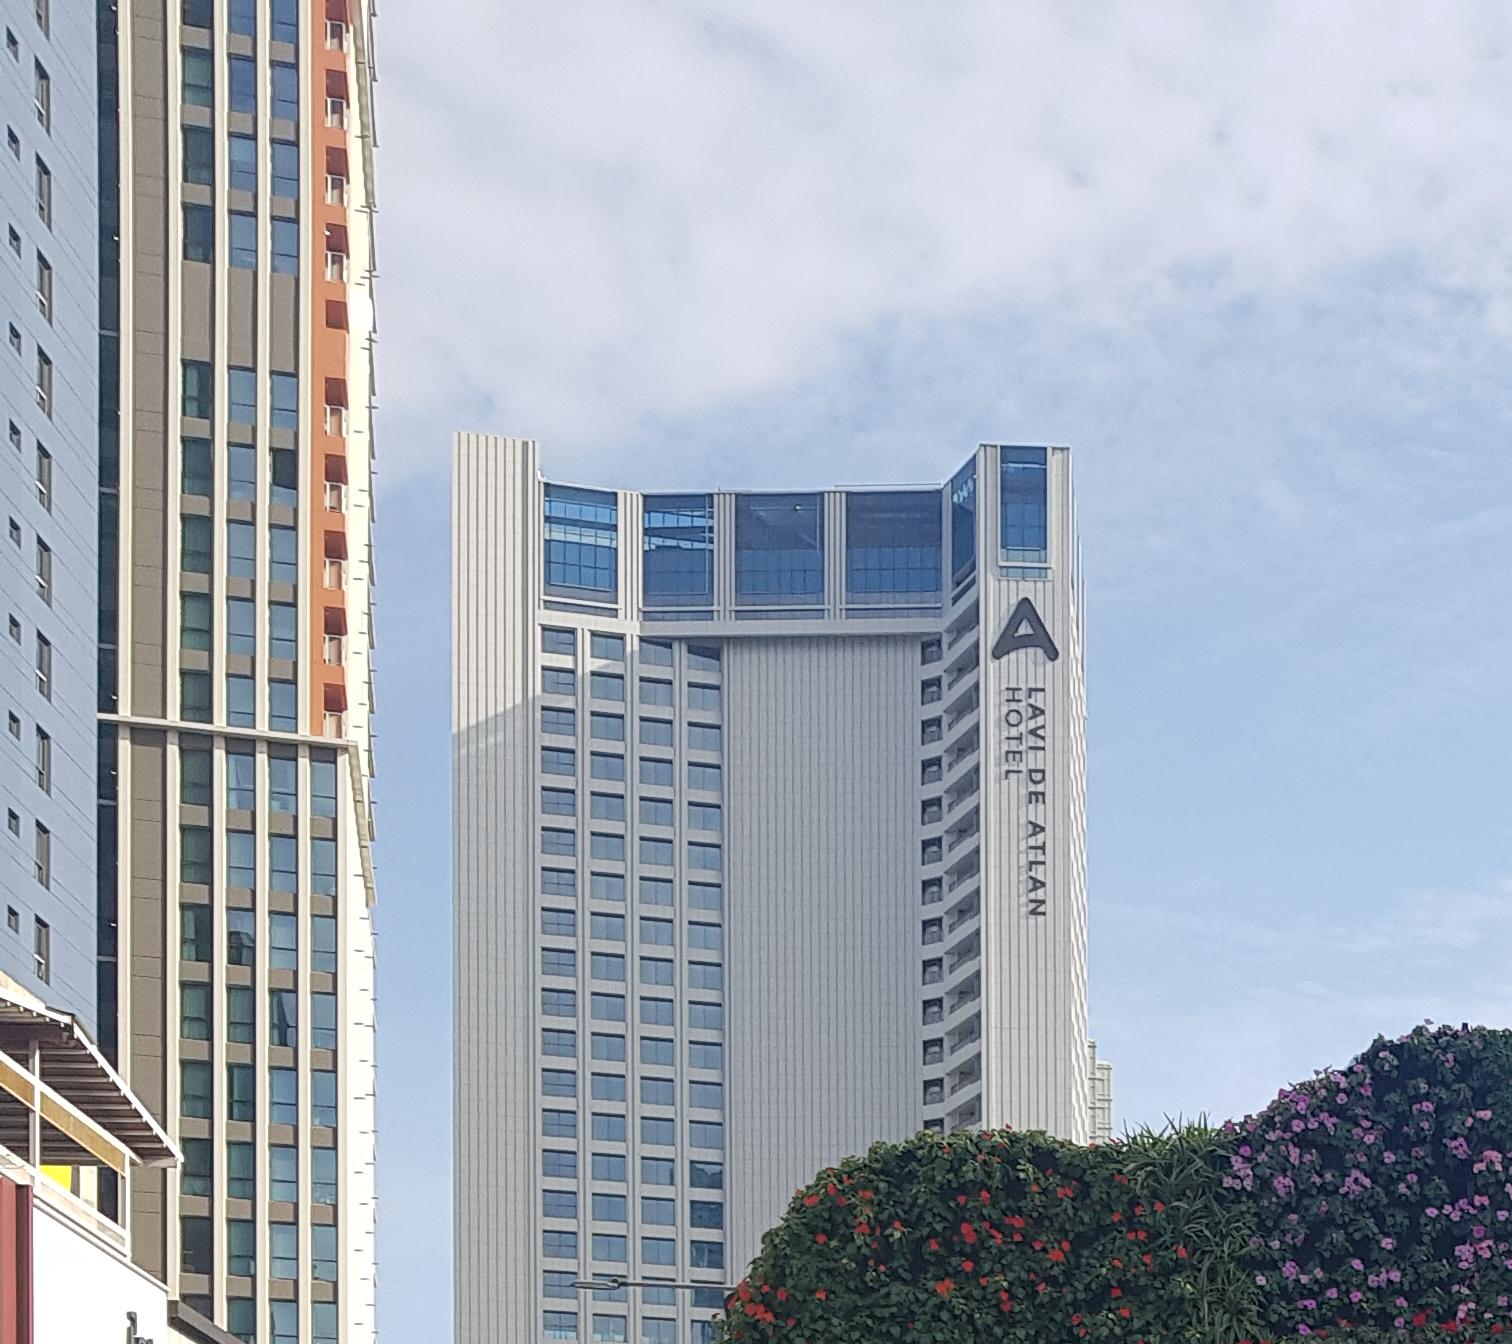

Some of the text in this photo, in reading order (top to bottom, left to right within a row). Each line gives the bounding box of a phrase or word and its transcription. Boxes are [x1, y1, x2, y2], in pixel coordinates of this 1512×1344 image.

[1004, 686, 1023, 780] HOTEL
[1027, 686, 1047, 917] LAVI DE ATLAN
